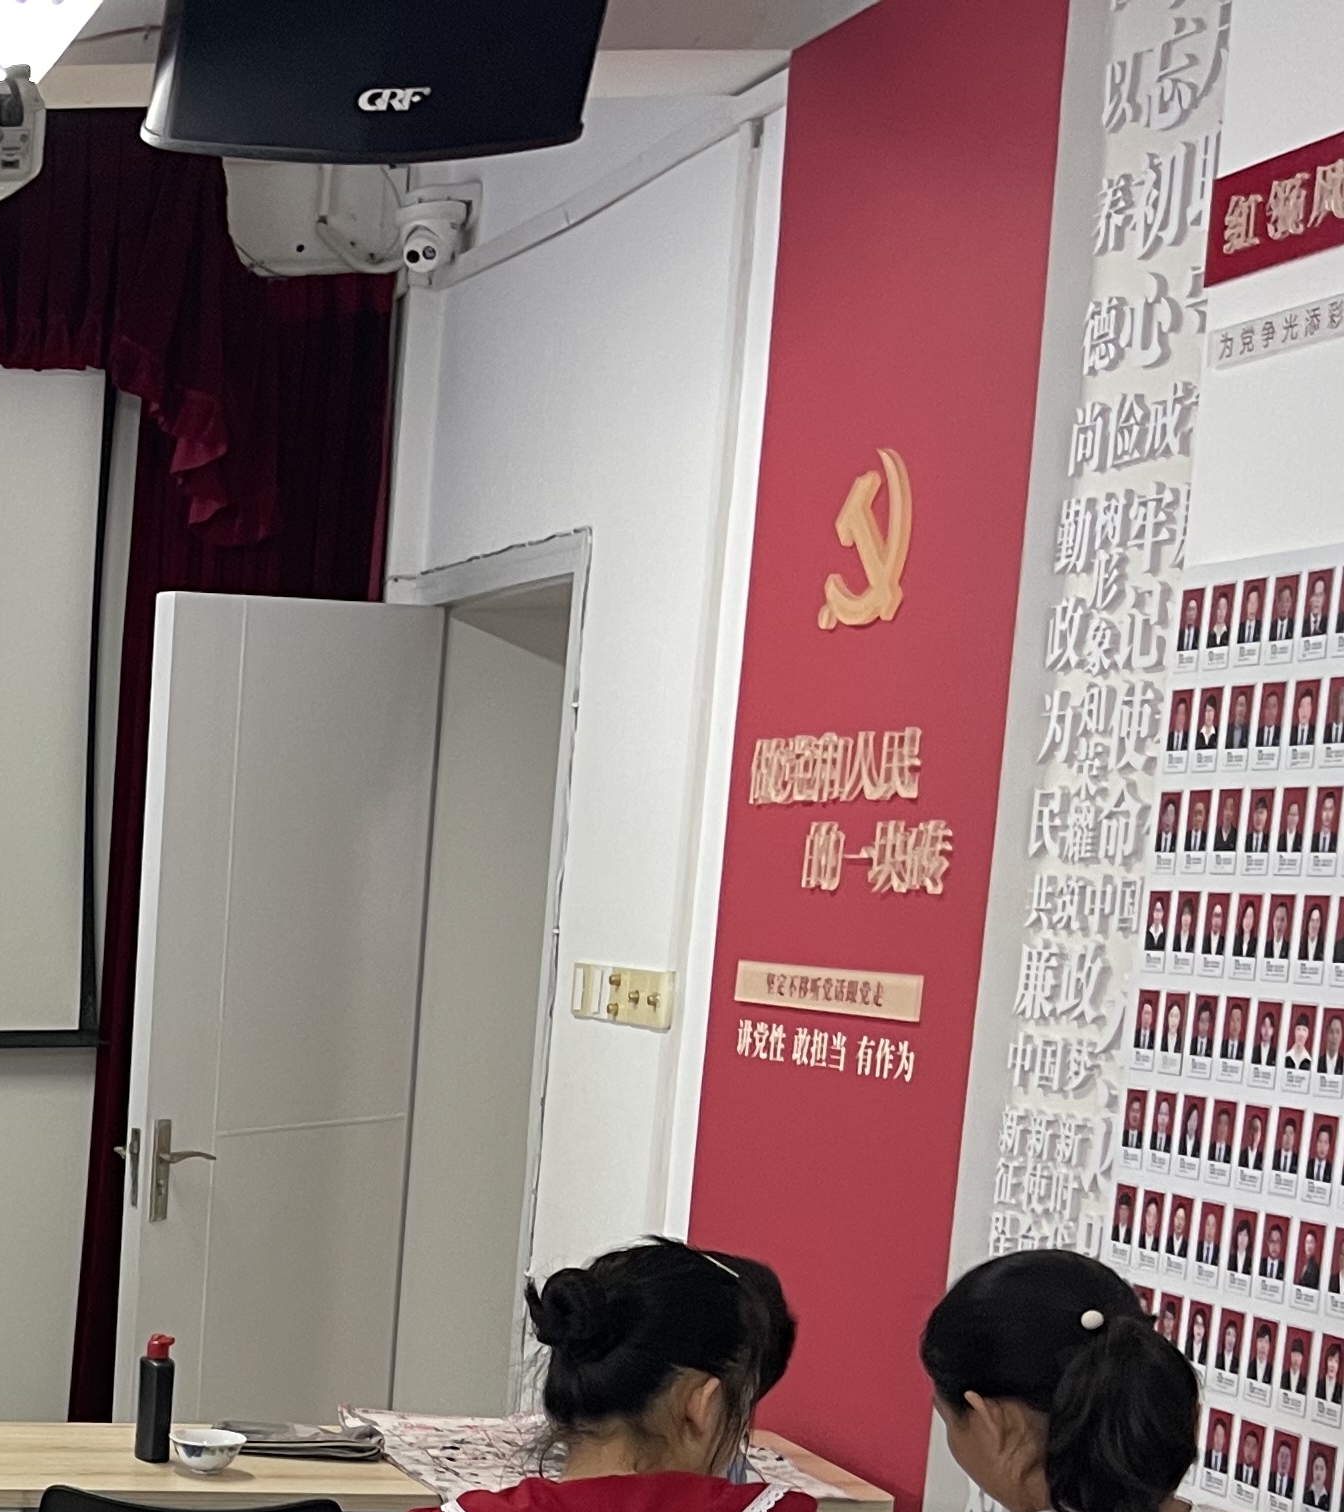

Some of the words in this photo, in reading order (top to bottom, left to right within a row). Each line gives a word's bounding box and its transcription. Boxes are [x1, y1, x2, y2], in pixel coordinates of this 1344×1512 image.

[1027, 497, 1098, 859] 勤政为民
[1098, 483, 1183, 872] 牢记使命
[736, 1018, 787, 1063] 讲党性
[791, 1026, 848, 1072] 敢担当
[855, 1034, 916, 1083] 有作为
